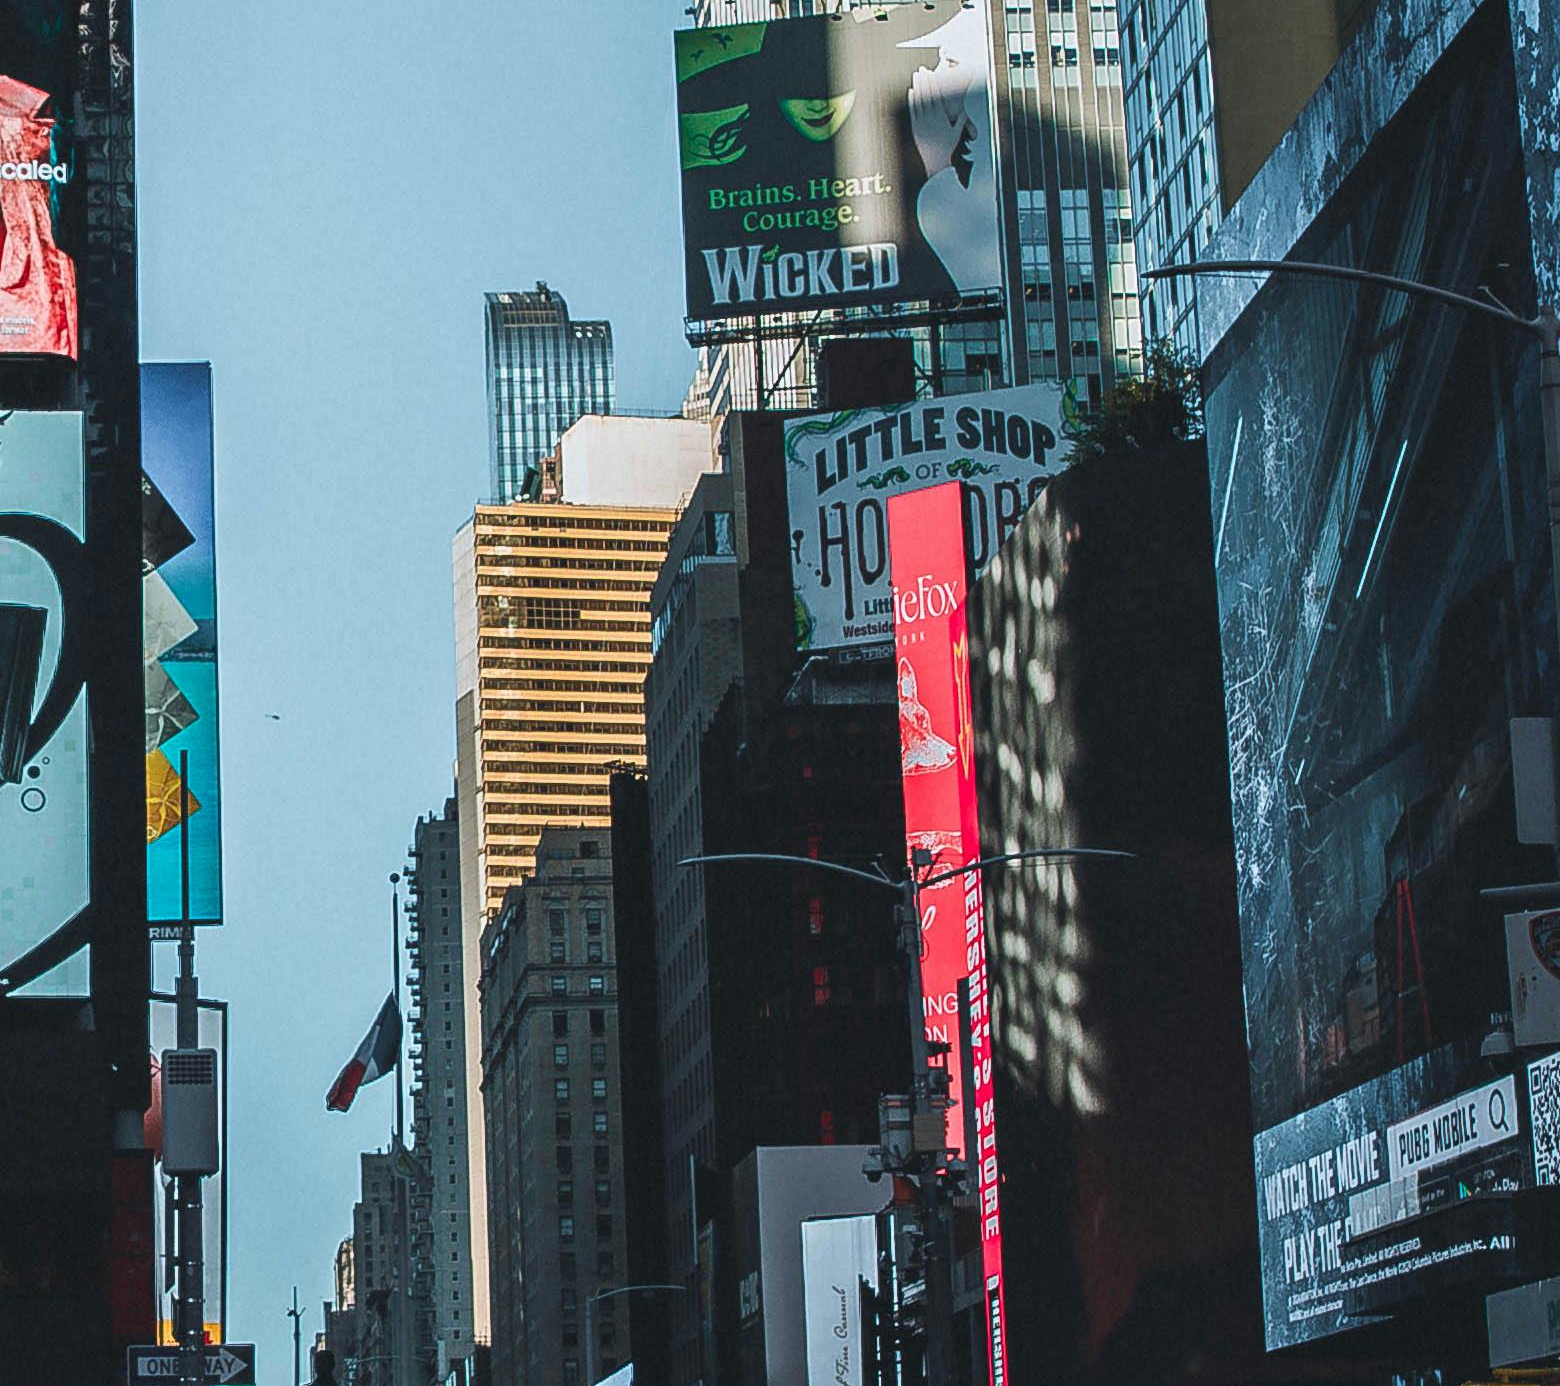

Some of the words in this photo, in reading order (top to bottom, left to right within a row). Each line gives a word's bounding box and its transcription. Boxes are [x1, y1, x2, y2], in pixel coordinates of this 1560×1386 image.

[709, 184, 802, 210] Brains.
[809, 173, 893, 199] Heart.
[743, 202, 859, 233] Courage.
[815, 406, 946, 496] LITTLE
[956, 406, 1056, 466] SHOP
[915, 463, 940, 480] OF
[979, 1089, 1002, 1242] STORE
[1398, 1128, 1429, 1168] PUBG
[1432, 1103, 1477, 1154] MOBILE
[1264, 1160, 1308, 1222] WATCH
[1309, 1149, 1334, 1202] THE
[1335, 1131, 1380, 1195] MOVIE
[1284, 1229, 1316, 1284] PLAY
[1317, 1220, 1343, 1273] THE
[146, 1359, 180, 1375] ONE
